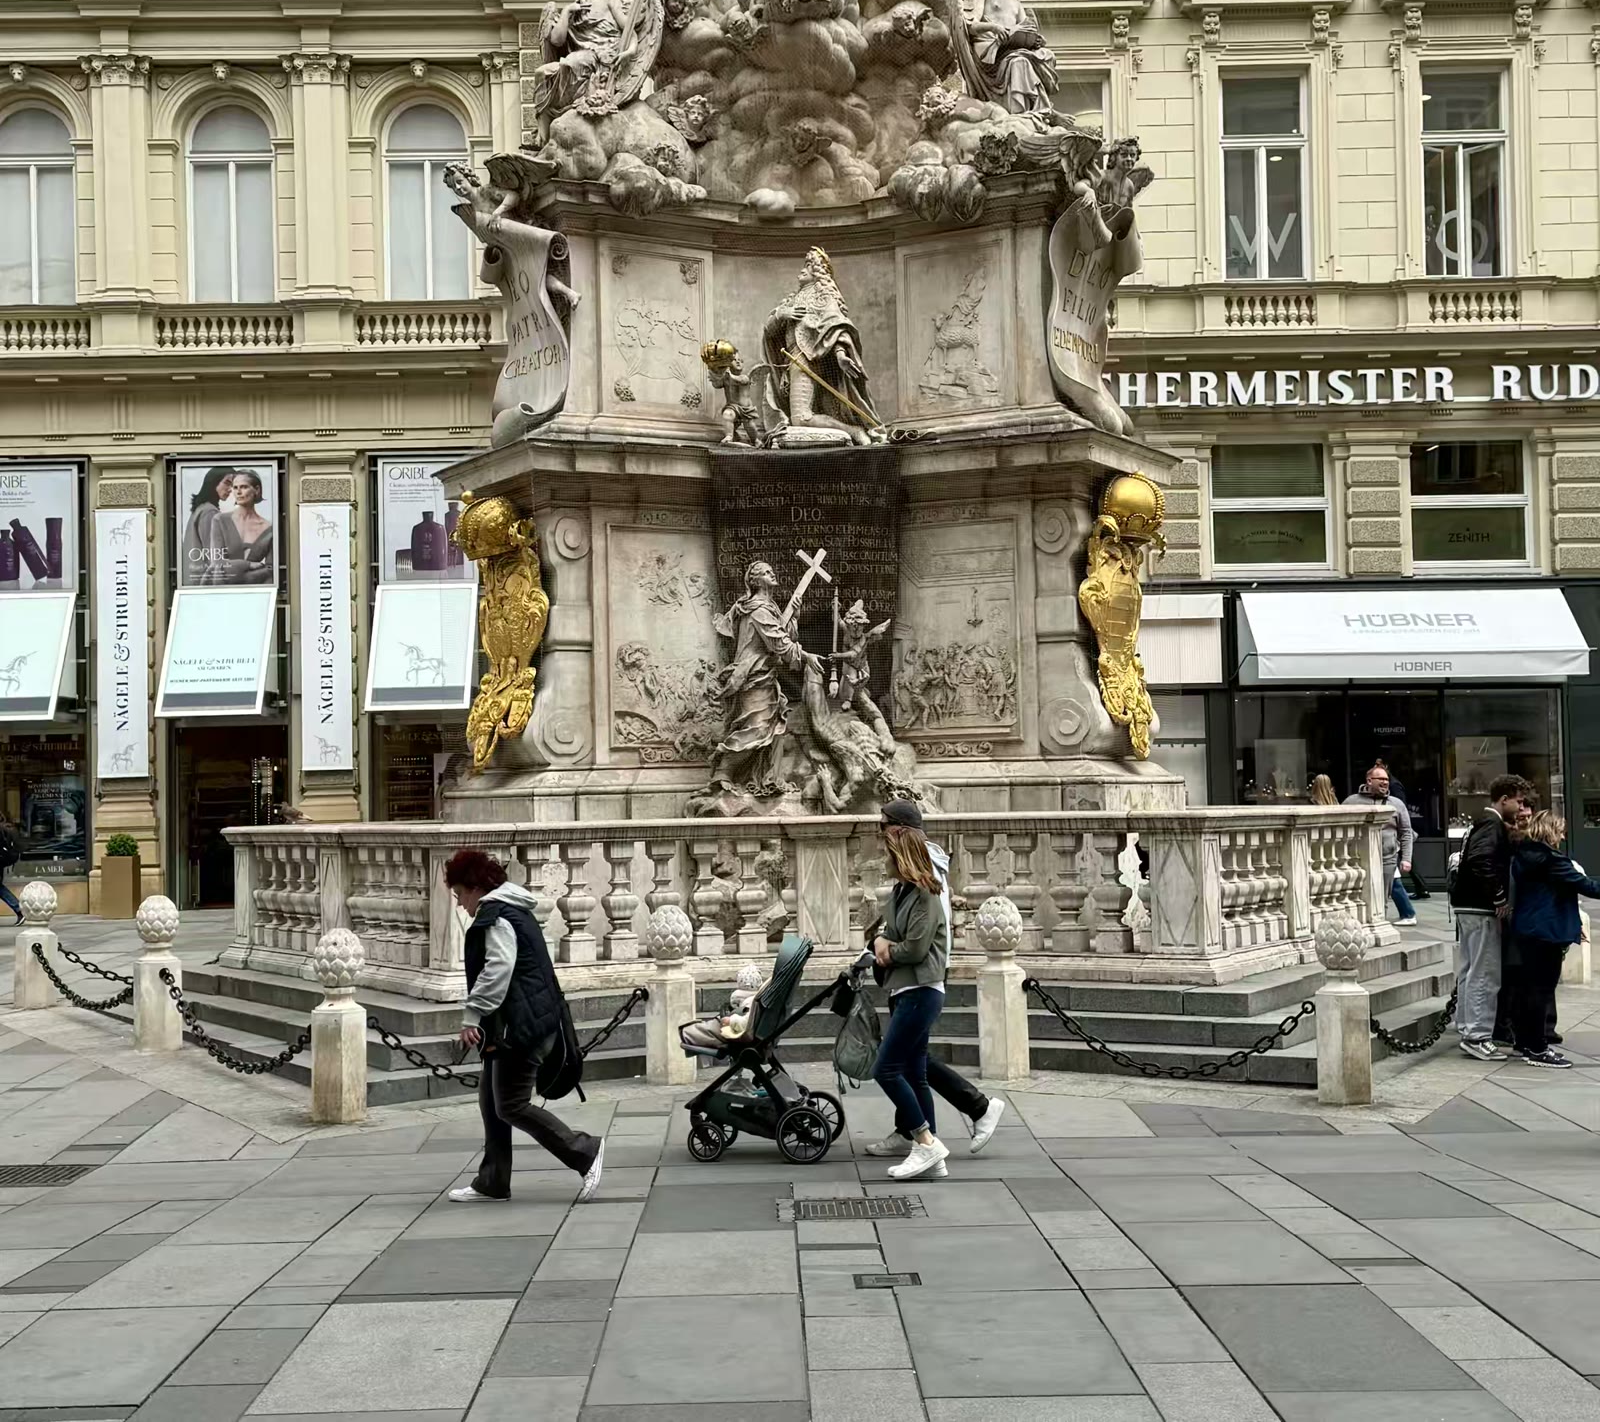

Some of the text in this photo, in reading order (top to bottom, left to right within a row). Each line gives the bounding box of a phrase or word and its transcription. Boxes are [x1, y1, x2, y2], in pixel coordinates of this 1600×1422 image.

[1062, 287, 1097, 326] FILIO
[1101, 365, 1455, 408] HERMEISTER
[389, 466, 429, 481] ORIBE
[1448, 532, 1490, 544] ZENITH
[188, 547, 229, 562] ORIBE
[1343, 613, 1478, 628] HÜBNER
[113, 554, 130, 731] NÄGELE & STRUBELL
[317, 548, 334, 725] NÄGELE & STRUBELL
[1394, 661, 1453, 672] HÜBNER
[48, 865, 65, 873] MER
